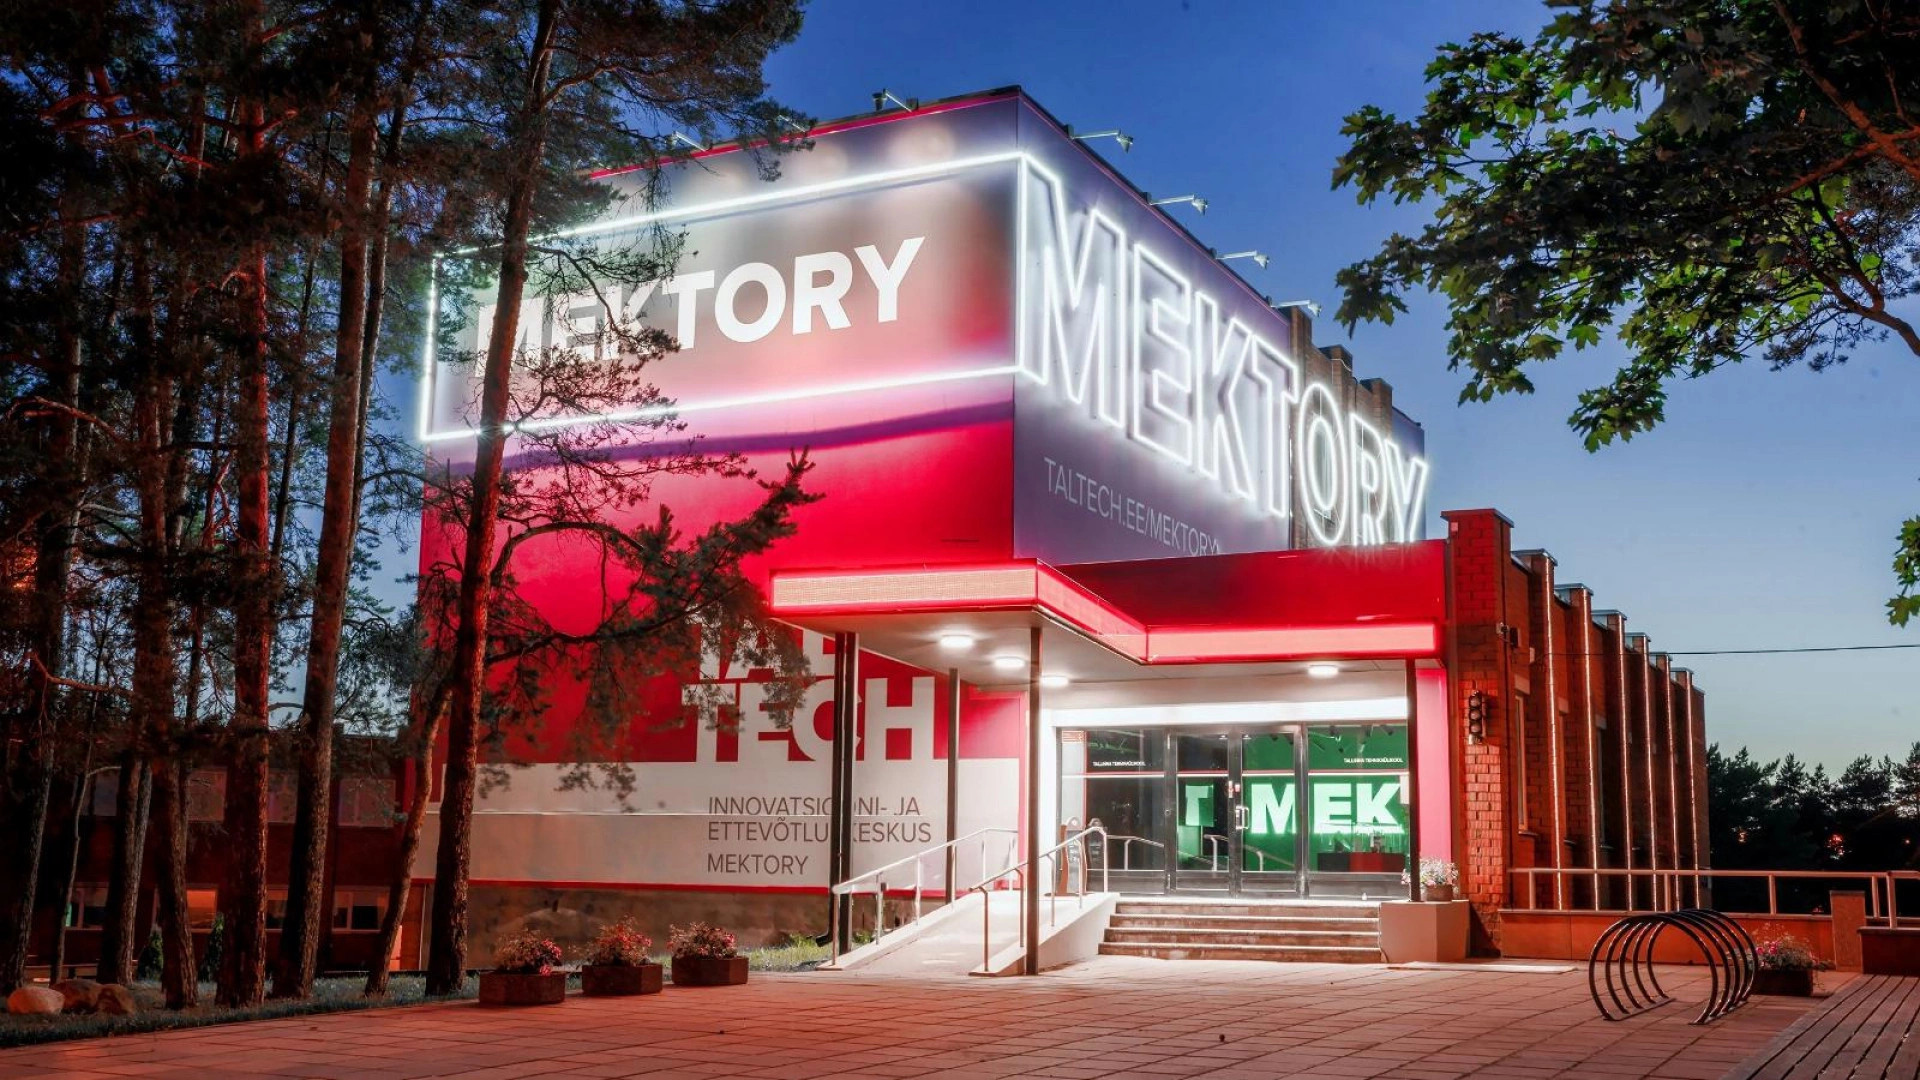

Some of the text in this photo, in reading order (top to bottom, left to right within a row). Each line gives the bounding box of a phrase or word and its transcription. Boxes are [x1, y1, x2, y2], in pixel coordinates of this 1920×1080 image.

[1019, 152, 1430, 546] MEKTORY
[681, 676, 936, 763] TECH
[708, 796, 921, 816] INNOVATSIONI- JA
[708, 817, 932, 843] ETTEVÕTLUESKUS
[707, 854, 809, 875] MEKTORY
